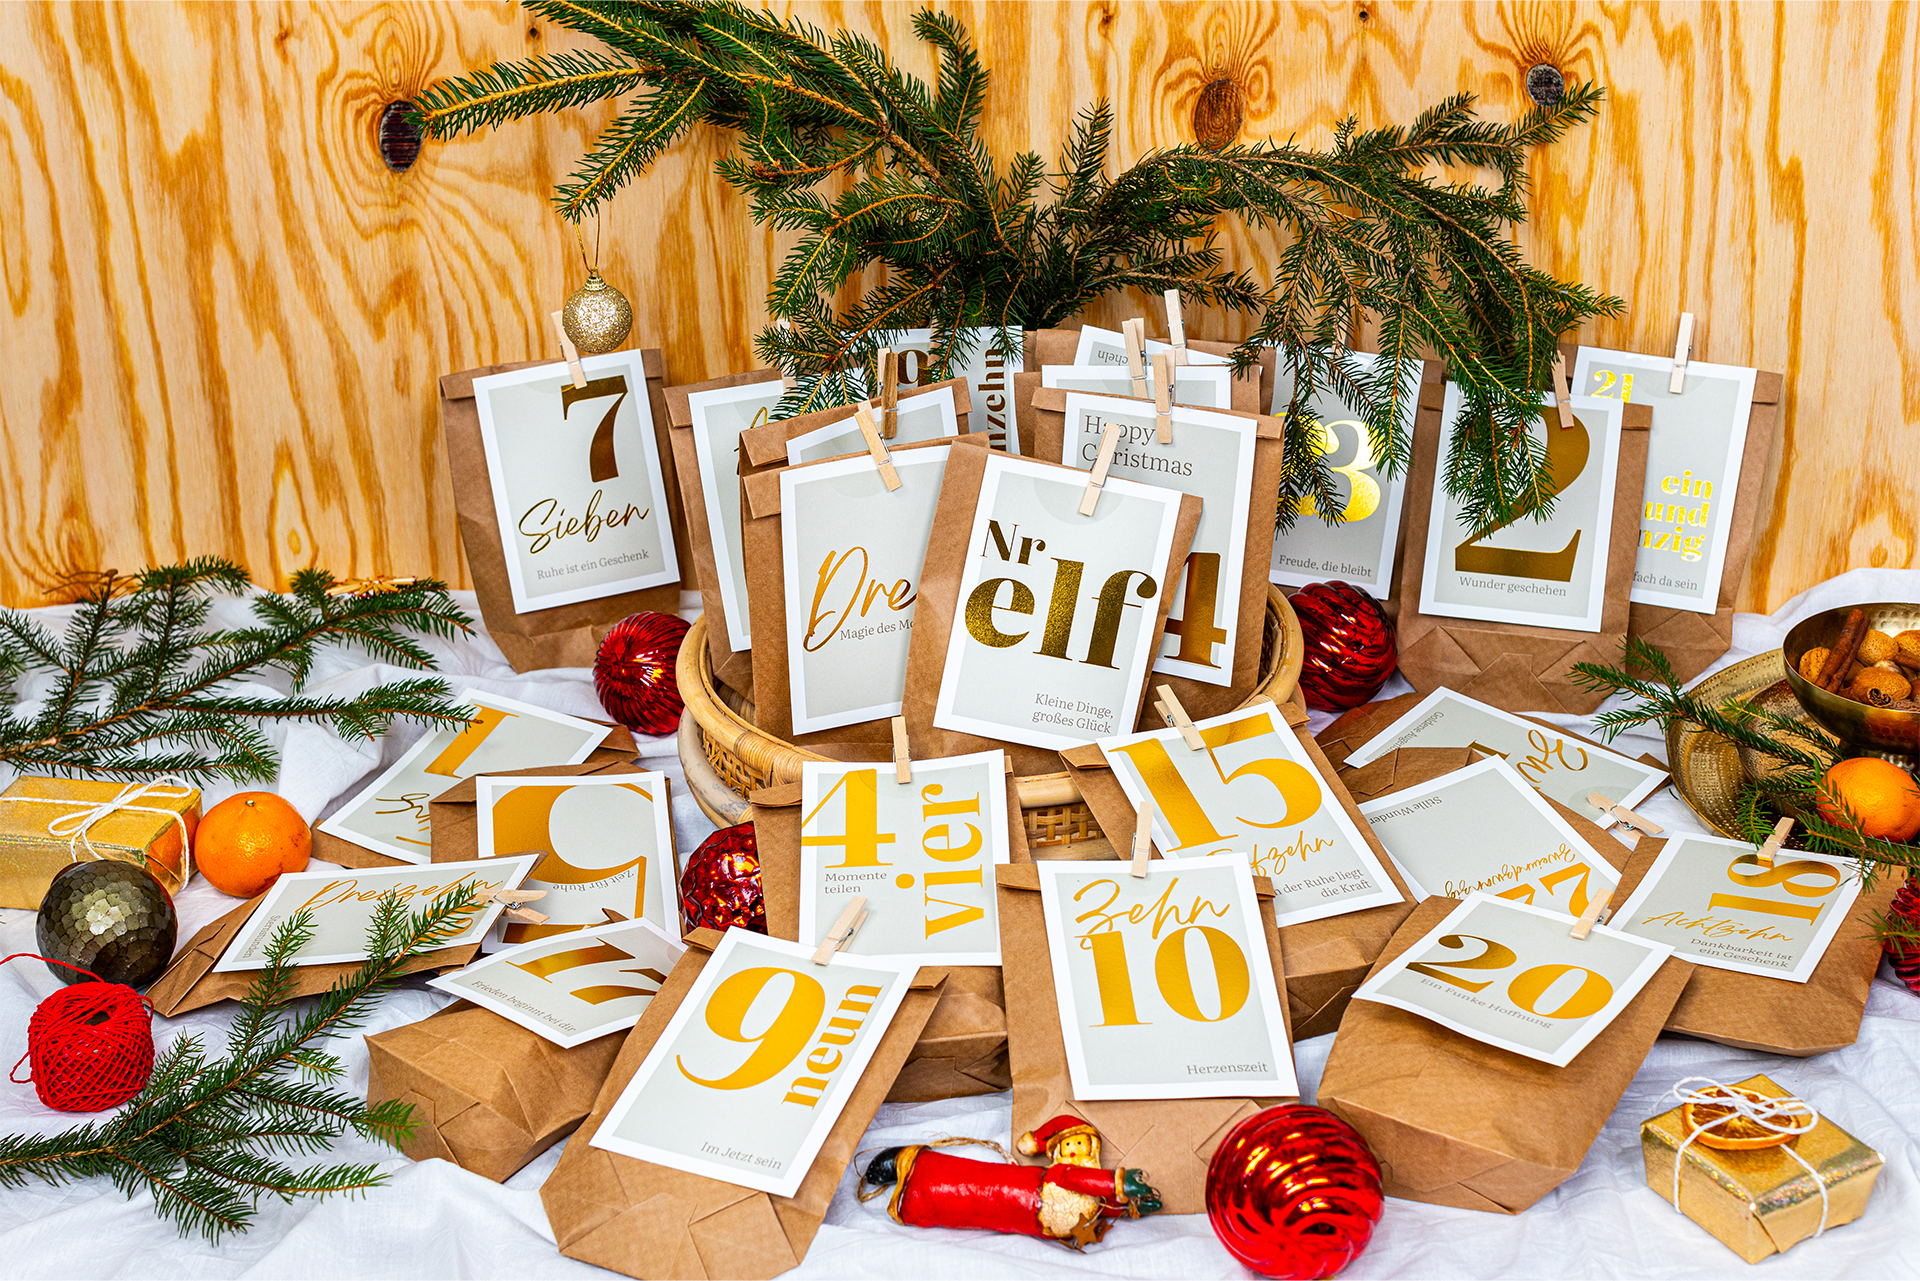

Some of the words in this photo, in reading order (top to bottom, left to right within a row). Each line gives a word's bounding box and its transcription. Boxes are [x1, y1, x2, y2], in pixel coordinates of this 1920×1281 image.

[1098, 349, 1129, 364] cheln
[977, 349, 1007, 451] nzehn
[1590, 369, 1634, 403] 21
[561, 375, 629, 483] 7
[1084, 415, 1156, 446] Hppy
[1082, 443, 1194, 477] Cristmas
[1455, 406, 1591, 582] 2
[1661, 470, 1713, 499] ein
[518, 489, 650, 554] Sieben
[1644, 501, 1710, 528] und
[979, 519, 1047, 566] Nr
[1638, 526, 1706, 562] nzig
[537, 566, 565, 580] Ruhe
[566, 562, 580, 575] ist
[580, 559, 598, 571] ein
[598, 549, 650, 568] Geschenk
[1278, 554, 1319, 571] Freude,
[1321, 557, 1339, 572] die
[1340, 560, 1372, 578] bleibt
[1459, 575, 1506, 591] Wunder
[1507, 580, 1567, 597] geschehen
[1633, 570, 1656, 586] fach
[1658, 574, 1673, 587] da
[1674, 577, 1698, 591] sein
[803, 546, 918, 652] Dre
[965, 557, 1158, 670] elf
[840, 625, 875, 641] Magie
[876, 622, 897, 634] des
[1035, 693, 1074, 711] Kleine
[1076, 701, 1114, 719] Dinge,
[1031, 710, 1075, 728] großes
[1076, 716, 1111, 734] Glück
[1413, 711, 1445, 733] Goldene
[1108, 712, 1322, 852] 15
[801, 768, 896, 868] 4
[1369, 806, 1415, 825] Wunder
[1412, 796, 1443, 810] Stille
[609, 869, 635, 884] Zeit
[896, 783, 985, 940] vier
[552, 883, 586, 893] Ruhe
[589, 879, 609, 889] für
[824, 884, 862, 894] teilen
[825, 872, 888, 883] Momente
[1283, 883, 1302, 896] der
[1303, 876, 1336, 890] Ruhe
[1336, 868, 1364, 882] liegt
[1320, 887, 1341, 899] die
[1341, 879, 1372, 894] Kraft
[1707, 853, 1842, 927] 18
[1073, 877, 1230, 950] Zehn
[1641, 911, 1794, 942] Achtzehn
[1691, 938, 1777, 959] Dankbarkeit
[1778, 952, 1793, 962] ist
[1699, 947, 1720, 957] ein
[1723, 951, 1789, 968] Geschenk
[1074, 925, 1251, 1027] 10
[1405, 934, 1614, 1019] 20
[471, 980, 509, 999] Frieden
[506, 995, 546, 1017] beginnt
[543, 1013, 562, 1026] bei
[558, 1020, 577, 1032] dir
[1420, 978, 1443, 991] Ein
[1444, 987, 1487, 1008] Funke
[1487, 1002, 1554, 1030] Hoffnung
[675, 966, 826, 1090] 9
[781, 984, 884, 1110] neun
[1186, 1061, 1269, 1075] Herzenszeit
[700, 1141, 721, 1155] Im
[721, 1146, 753, 1163] Jetzt
[753, 1155, 782, 1170] sein
